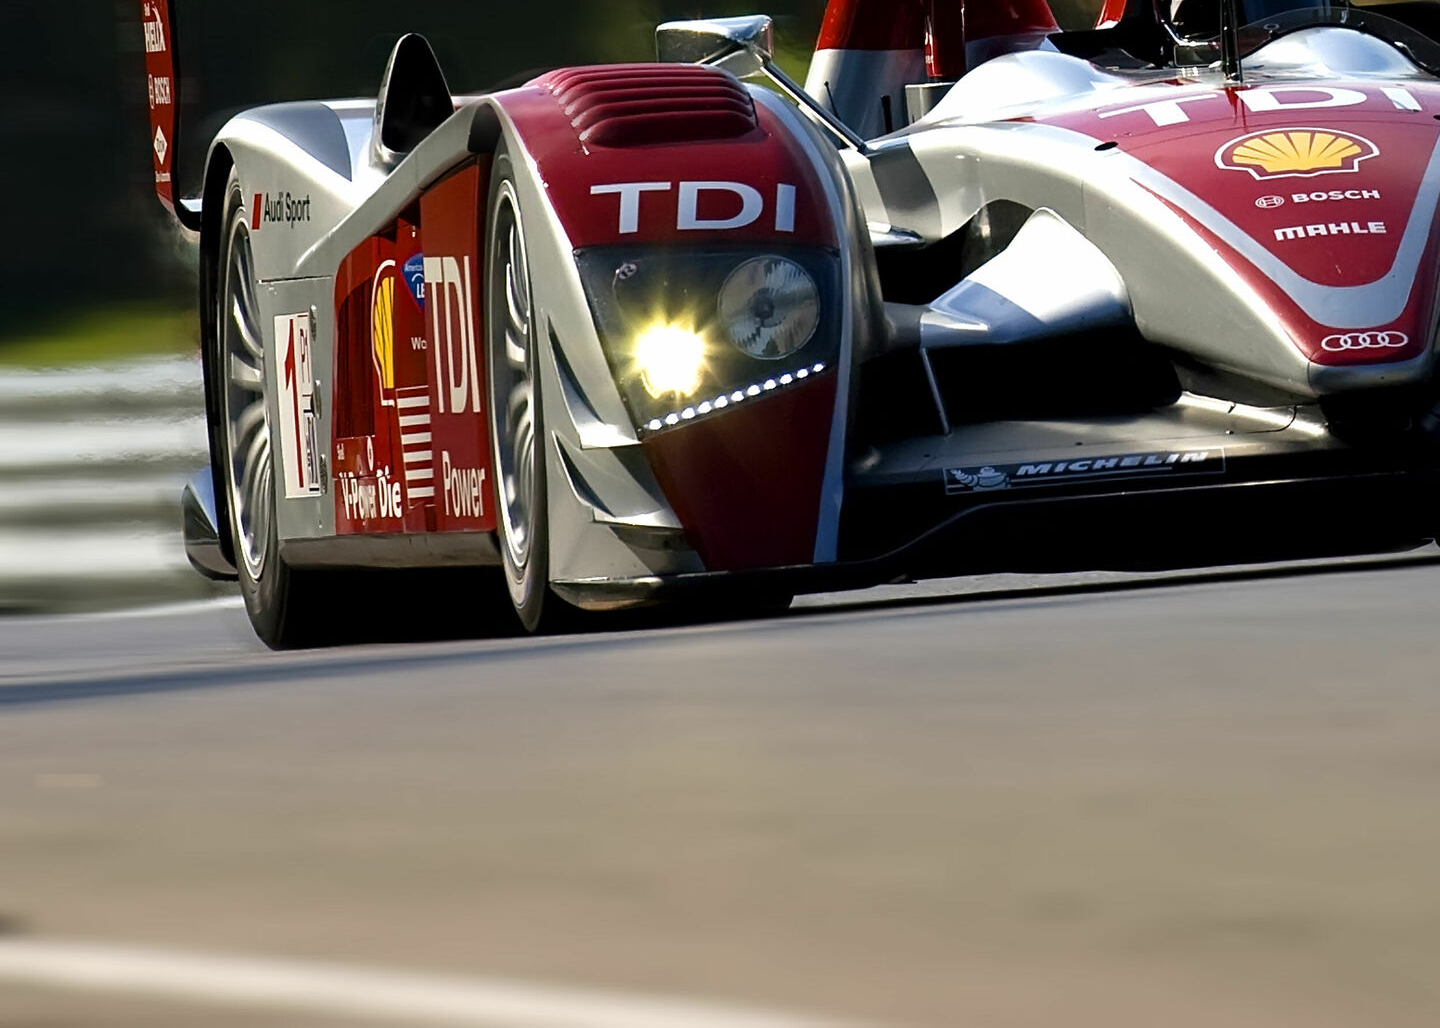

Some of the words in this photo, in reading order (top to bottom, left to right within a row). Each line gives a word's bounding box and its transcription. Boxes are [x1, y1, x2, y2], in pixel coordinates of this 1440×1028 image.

[1099, 86, 1423, 127] TDI
[263, 191, 284, 222] Audi
[285, 191, 310, 229] Sport
[590, 180, 797, 234] TDI
[1291, 189, 1381, 203] BOSCH
[1273, 221, 1387, 241] MAHLE
[422, 255, 481, 414] TDI
[284, 318, 304, 488] 1
[441, 450, 486, 518] Power
[1015, 451, 1209, 476] MICHELIN
